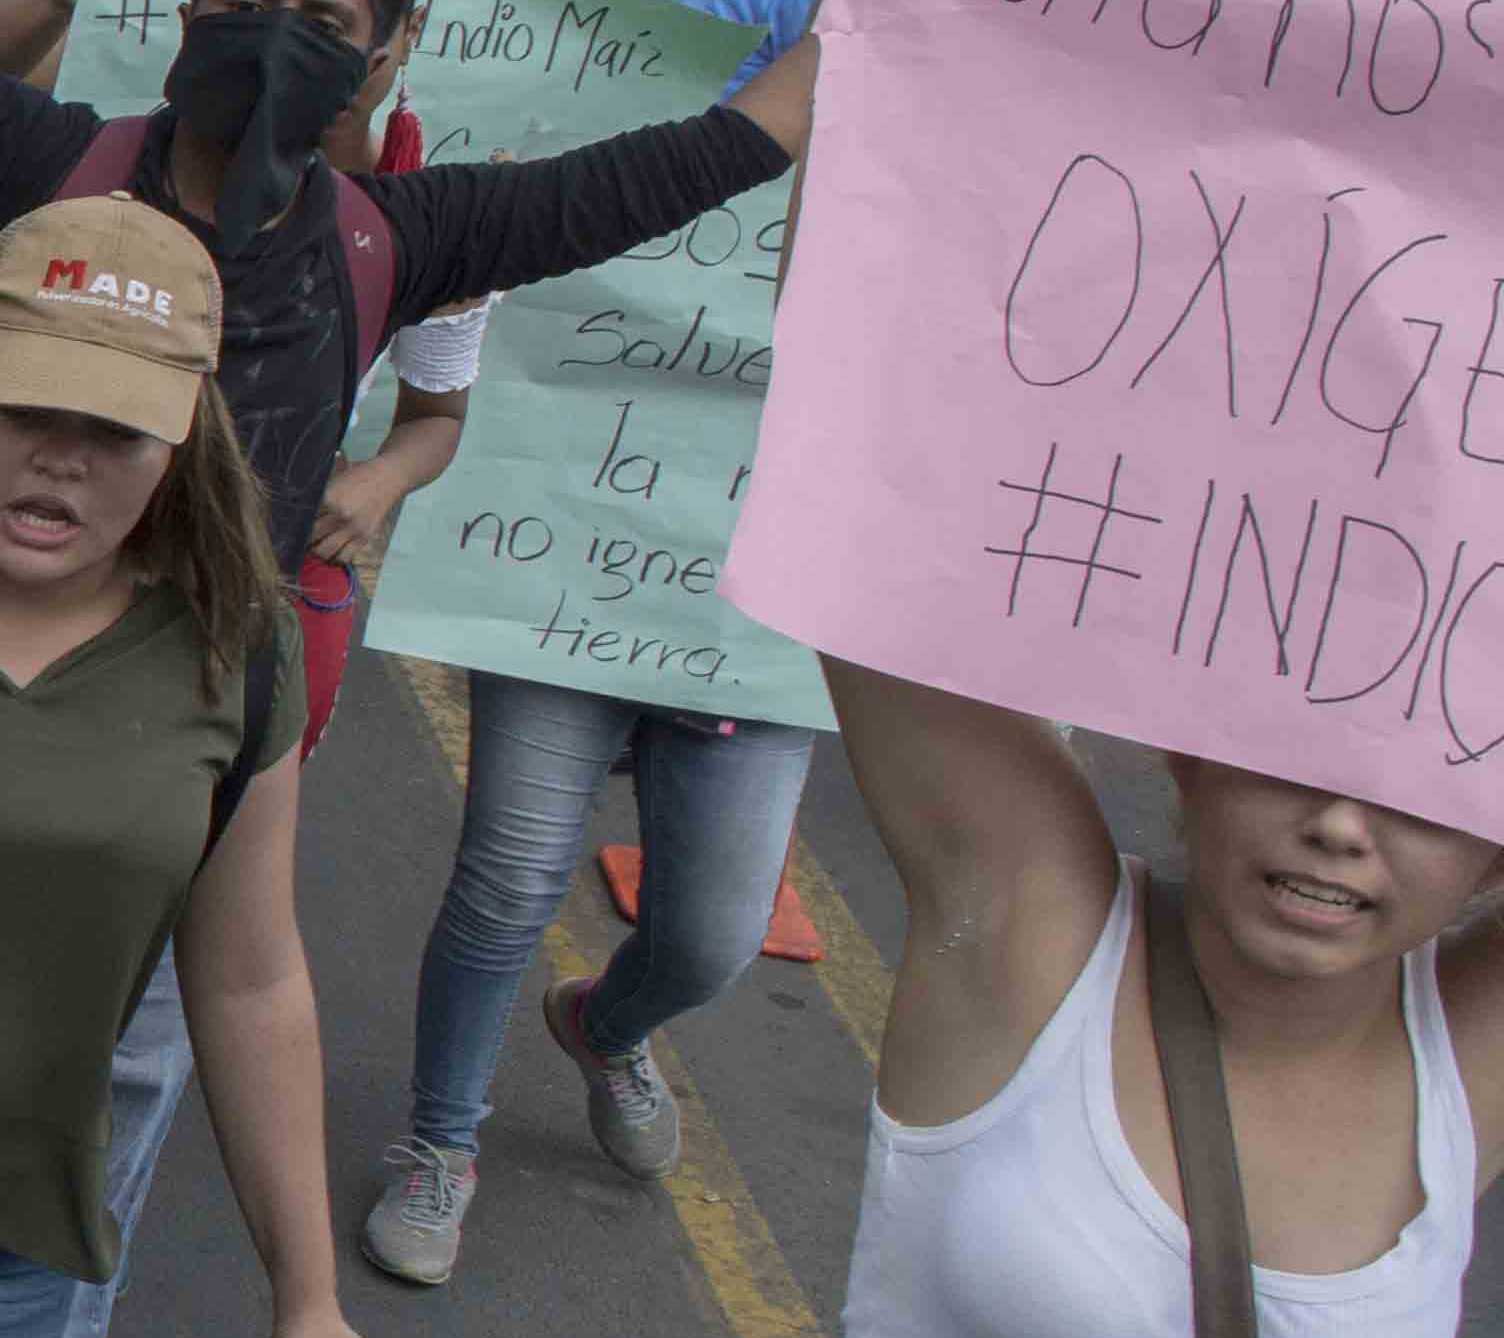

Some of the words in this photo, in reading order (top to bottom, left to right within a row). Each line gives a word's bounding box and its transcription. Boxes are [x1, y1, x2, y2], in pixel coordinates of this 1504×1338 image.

[40, 258, 174, 317] MADE
[1004, 152, 1504, 481] OXÍGE
[592, 400, 656, 499] la
[459, 510, 554, 564] no
